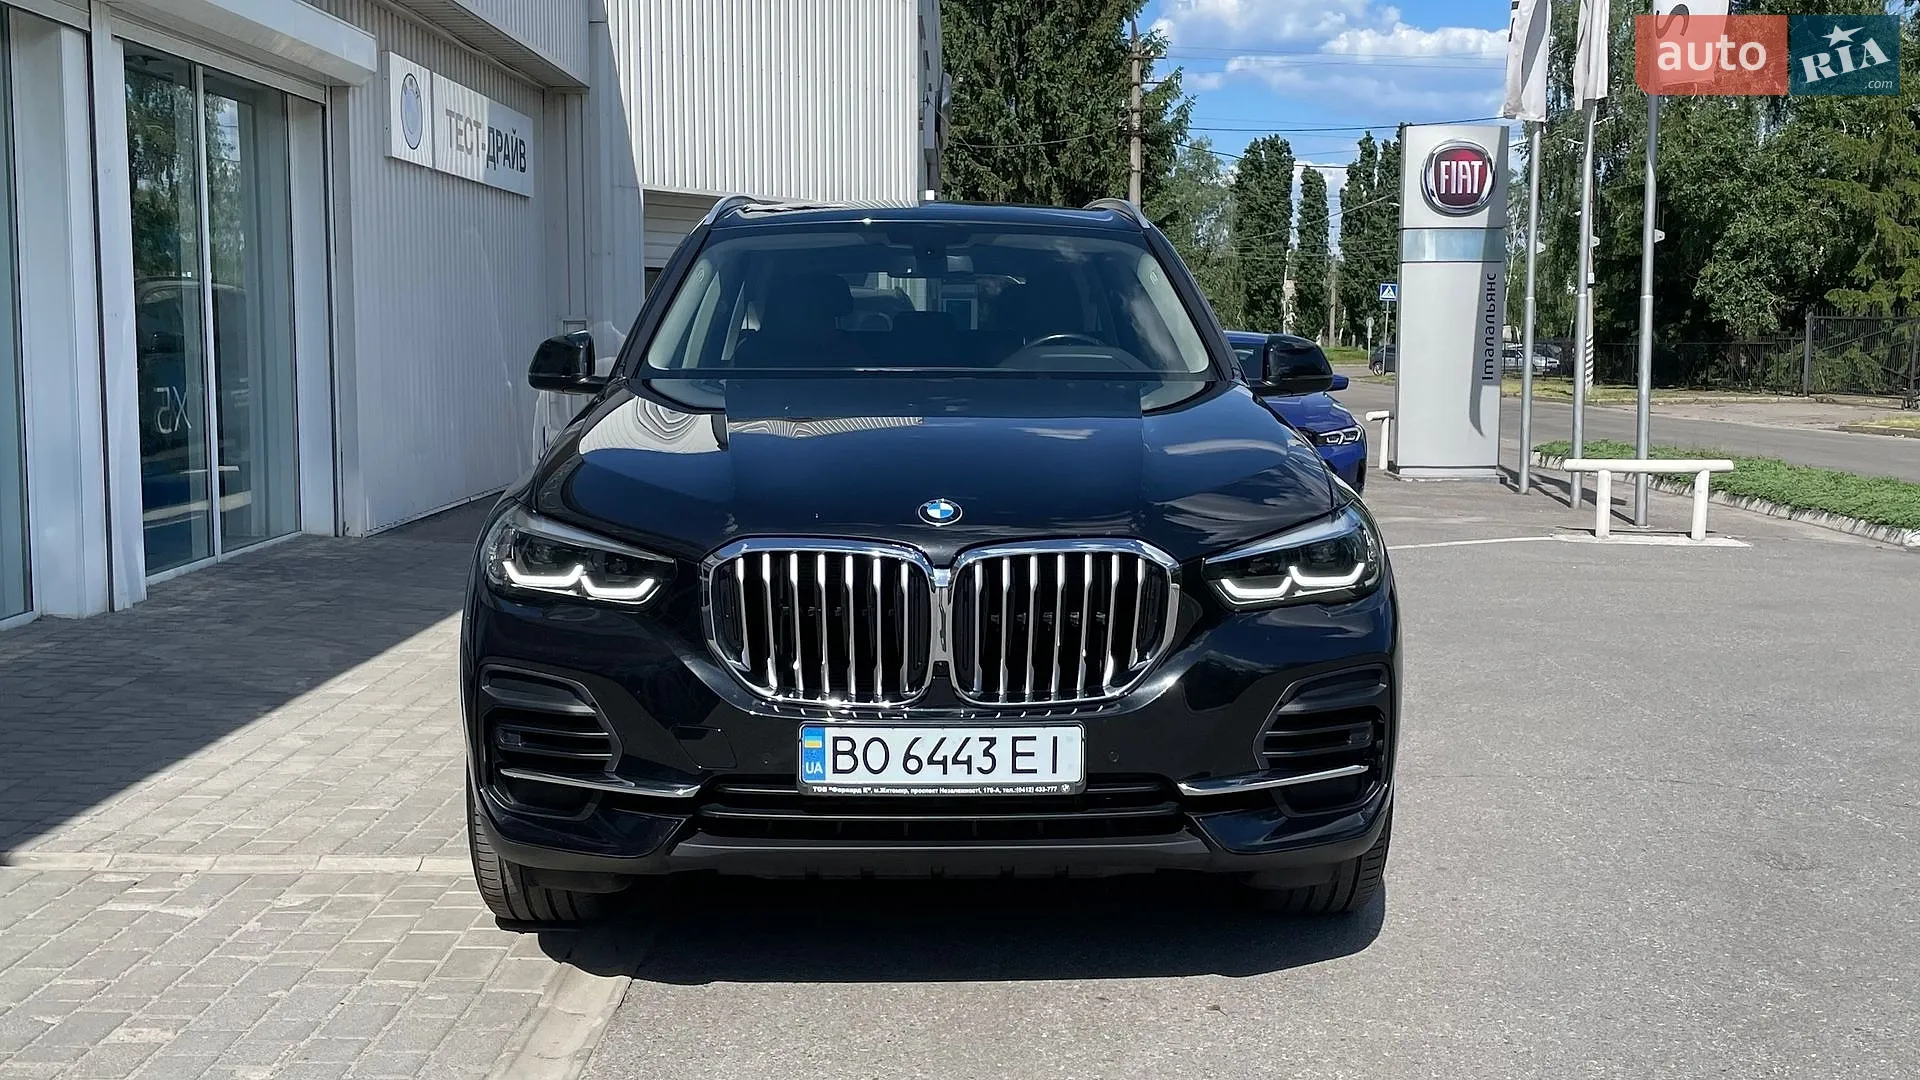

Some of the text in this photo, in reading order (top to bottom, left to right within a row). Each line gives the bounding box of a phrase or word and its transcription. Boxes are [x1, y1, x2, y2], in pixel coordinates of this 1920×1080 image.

[445, 108, 527, 173] ТЕСТ-ДРАЙВ
[1439, 160, 1483, 194] FIAT
[805, 762, 824, 775] UA
[832, 735, 1059, 775] BO 6443 EI
